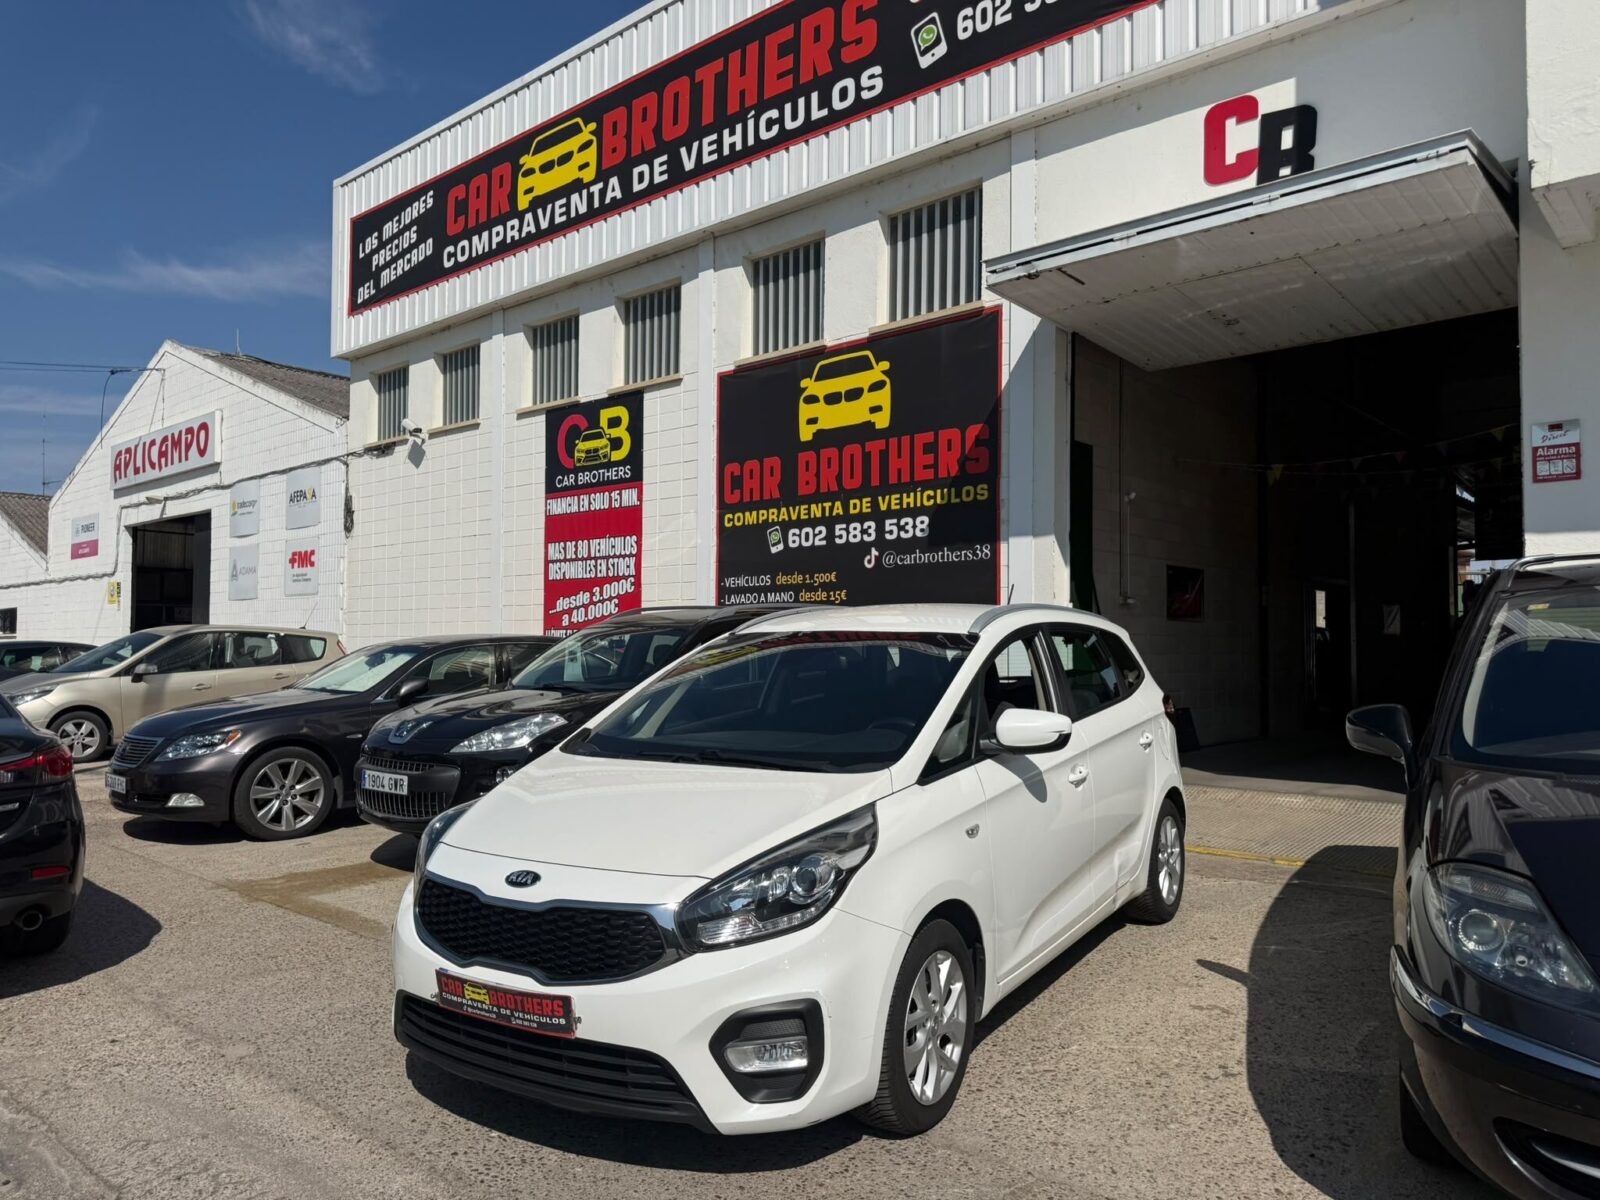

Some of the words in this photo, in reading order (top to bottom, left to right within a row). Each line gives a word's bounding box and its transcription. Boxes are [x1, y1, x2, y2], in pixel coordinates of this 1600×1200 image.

[957, 0, 1012, 40] 602
[446, 161, 512, 236] CAR
[601, 0, 878, 170] BROTHERS
[442, 175, 622, 269] COMPRAVENTA
[632, 154, 668, 193] DE
[680, 65, 883, 172] VEHÍCULOS
[359, 231, 378, 259] LOS
[382, 190, 434, 241] MEJORES
[372, 225, 417, 272] PRECIOS
[357, 280, 376, 304] DEL
[380, 237, 433, 289] MERCADO
[113, 421, 209, 485] APLICAMPO
[724, 456, 782, 504] CAR
[797, 424, 990, 496] BROTHERS
[1536, 446, 1576, 456] Alarma
[555, 474, 575, 488] CAR
[578, 465, 631, 484] BROTHERS
[546, 496, 579, 515] FINANCIA
[580, 494, 589, 511] EN
[590, 491, 610, 511] SOLO
[611, 490, 620, 508] 15
[621, 488, 640, 507] MIN.
[724, 500, 843, 528] COMPRAVENTA
[850, 497, 871, 514] DE
[878, 484, 989, 511] VEHÍCULOS
[787, 527, 827, 548] 602
[835, 521, 876, 544] 583
[885, 516, 929, 539] 538
[289, 549, 315, 569] FMC
[548, 542, 564, 560] MAS
[566, 541, 576, 559] DE
[577, 540, 588, 558] 80
[590, 534, 637, 557] VEHÍCULOS
[882, 544, 991, 568] @carbrothers38
[549, 560, 595, 580] DISPONIBLES
[597, 559, 607, 577] EN
[608, 557, 636, 577] STOCK
[776, 571, 803, 585] desde
[805, 572, 837, 586] 1.500€
[592, 577, 635, 602] 3.000€
[760, 591, 766, 603] A
[767, 591, 794, 603] MANO
[799, 588, 827, 602] desde
[829, 590, 847, 603] 15€
[562, 614, 569, 626] a
[571, 599, 618, 624] 40.000€
[368, 773, 385, 789] 1904
[388, 777, 404, 792] GWR
[508, 871, 534, 885] KIA
[442, 975, 463, 997] CAR
[489, 991, 564, 1016] BROTHERS
[442, 992, 498, 1013] COMPRAVENTA
[500, 1007, 512, 1016] DE
[513, 1011, 566, 1025] VEHÍCULOS
